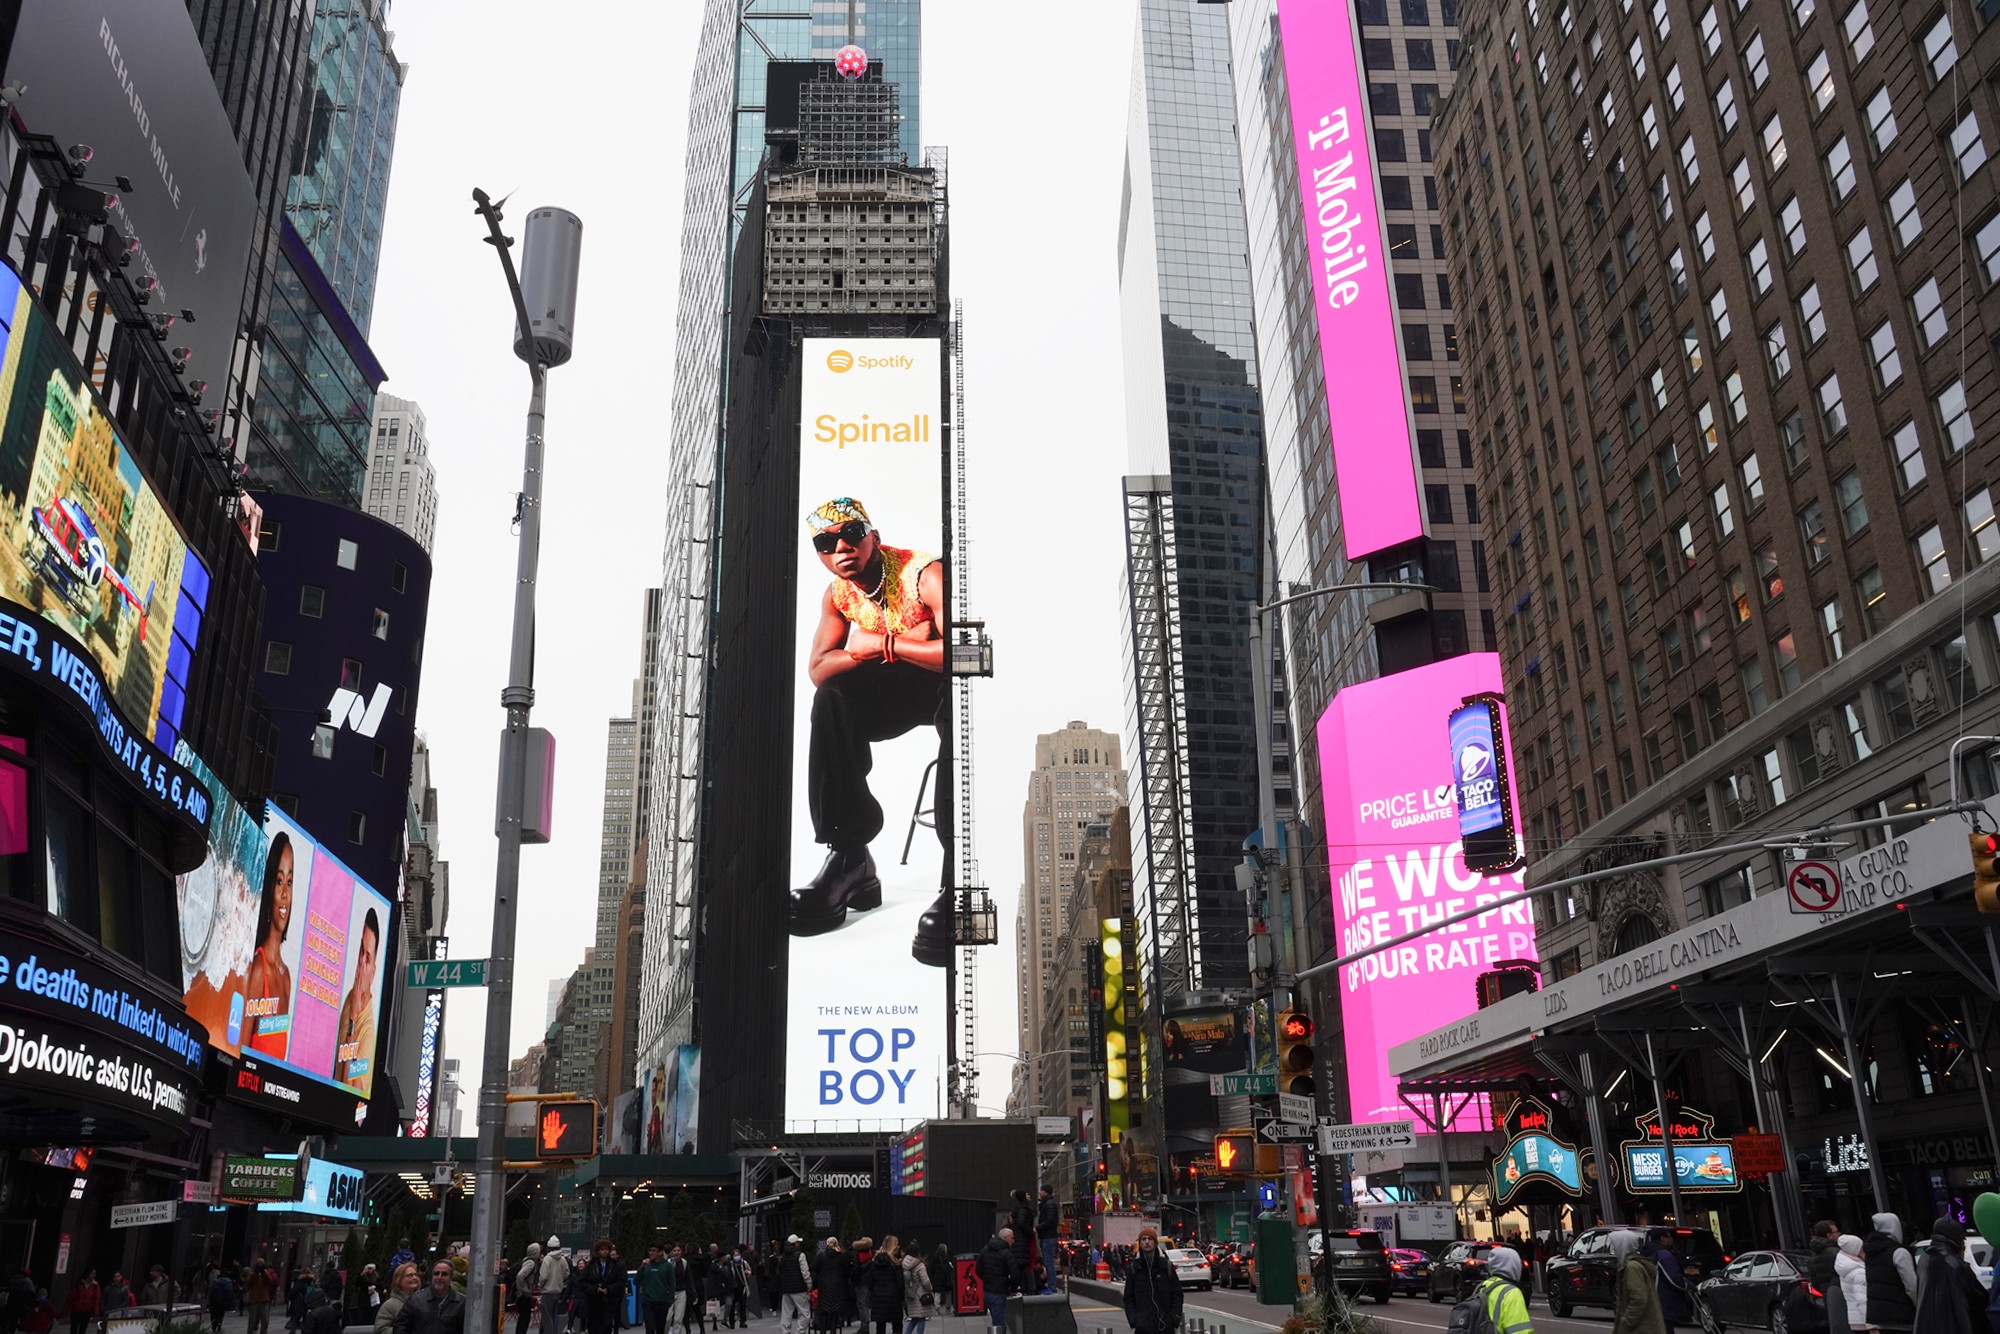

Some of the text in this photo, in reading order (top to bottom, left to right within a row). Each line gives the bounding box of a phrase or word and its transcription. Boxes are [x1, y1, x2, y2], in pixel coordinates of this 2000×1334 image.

[99, 16, 181, 210] RICHARD MILLE
[857, 355, 914, 370] Spotify
[814, 414, 929, 449] Spinall
[50, 640, 125, 756] WEEKNIGHTS
[121, 736, 142, 771] AT
[140, 755, 152, 789] 4,
[154, 763, 168, 800] 5,
[170, 775, 183, 811] 6,
[185, 785, 208, 825] AND
[1461, 778, 1494, 799] TACO
[1465, 792, 1497, 811] BELL
[1359, 792, 1417, 824] PRICE
[1391, 806, 1453, 829] GUARANTEE
[1858, 839, 1909, 878] GUMP
[1339, 859, 1376, 921] WE
[1880, 870, 1914, 898] CO.
[308, 910, 345, 947] NETFLIX'S
[1344, 888, 1535, 958] RAISE THE PRI
[307, 932, 342, 966] HOTTEST
[1597, 920, 1742, 996] TACO BELL CANTINA
[305, 954, 339, 987] SINGLES
[413, 962, 482, 985] W 44 ST
[1348, 965, 1359, 993] OF
[1358, 946, 1419, 985] YOUR
[1426, 934, 1501, 972] RATE
[15, 955, 90, 1010] deaths
[91, 986, 119, 1022] not
[118, 991, 157, 1039] linked
[155, 1012, 168, 1044] to
[167, 1022, 189, 1057] wind
[300, 975, 340, 1011] ARE BACK
[1544, 990, 1568, 1017] LIDS
[246, 997, 279, 1018] OLONY
[817, 1005, 918, 1016] THE NEW ALBUM
[338, 1041, 359, 1063] JOEY
[817, 1027, 916, 1063] TOP
[1420, 1020, 1480, 1058] HARD ROCK CAFE
[0, 1024, 95, 1082] Djokovic
[96, 1056, 130, 1093] asks
[131, 1063, 153, 1101] U.S.
[237, 1070, 300, 1103] NETFLIX NOW STREAMING
[819, 1069, 916, 1105] BOY
[1226, 1078, 1238, 1092] W
[1244, 1077, 1260, 1092] 44
[1267, 1125, 1313, 1136] ONE WA
[1331, 1124, 1410, 1138] PEDESTRIAN FLOW ZONE
[1675, 1124, 1699, 1137] Rock
[1332, 1139, 1376, 1150] KEEP MOVING
[1824, 1134, 1870, 1173] Lids
[1905, 1134, 1995, 1165] TACO BELL
[225, 1164, 295, 1177] TARBUCKS
[1632, 1153, 1661, 1166] MESSI
[1634, 1165, 1663, 1176] BURGER
[231, 1177, 278, 1189] COFFEE
[808, 1173, 824, 1181] NYC's
[823, 1174, 871, 1189] HOTDOGS
[114, 1204, 168, 1217] PEDESTRIAN FLOW ZONE
[136, 1213, 168, 1223] KEEP MOVING
